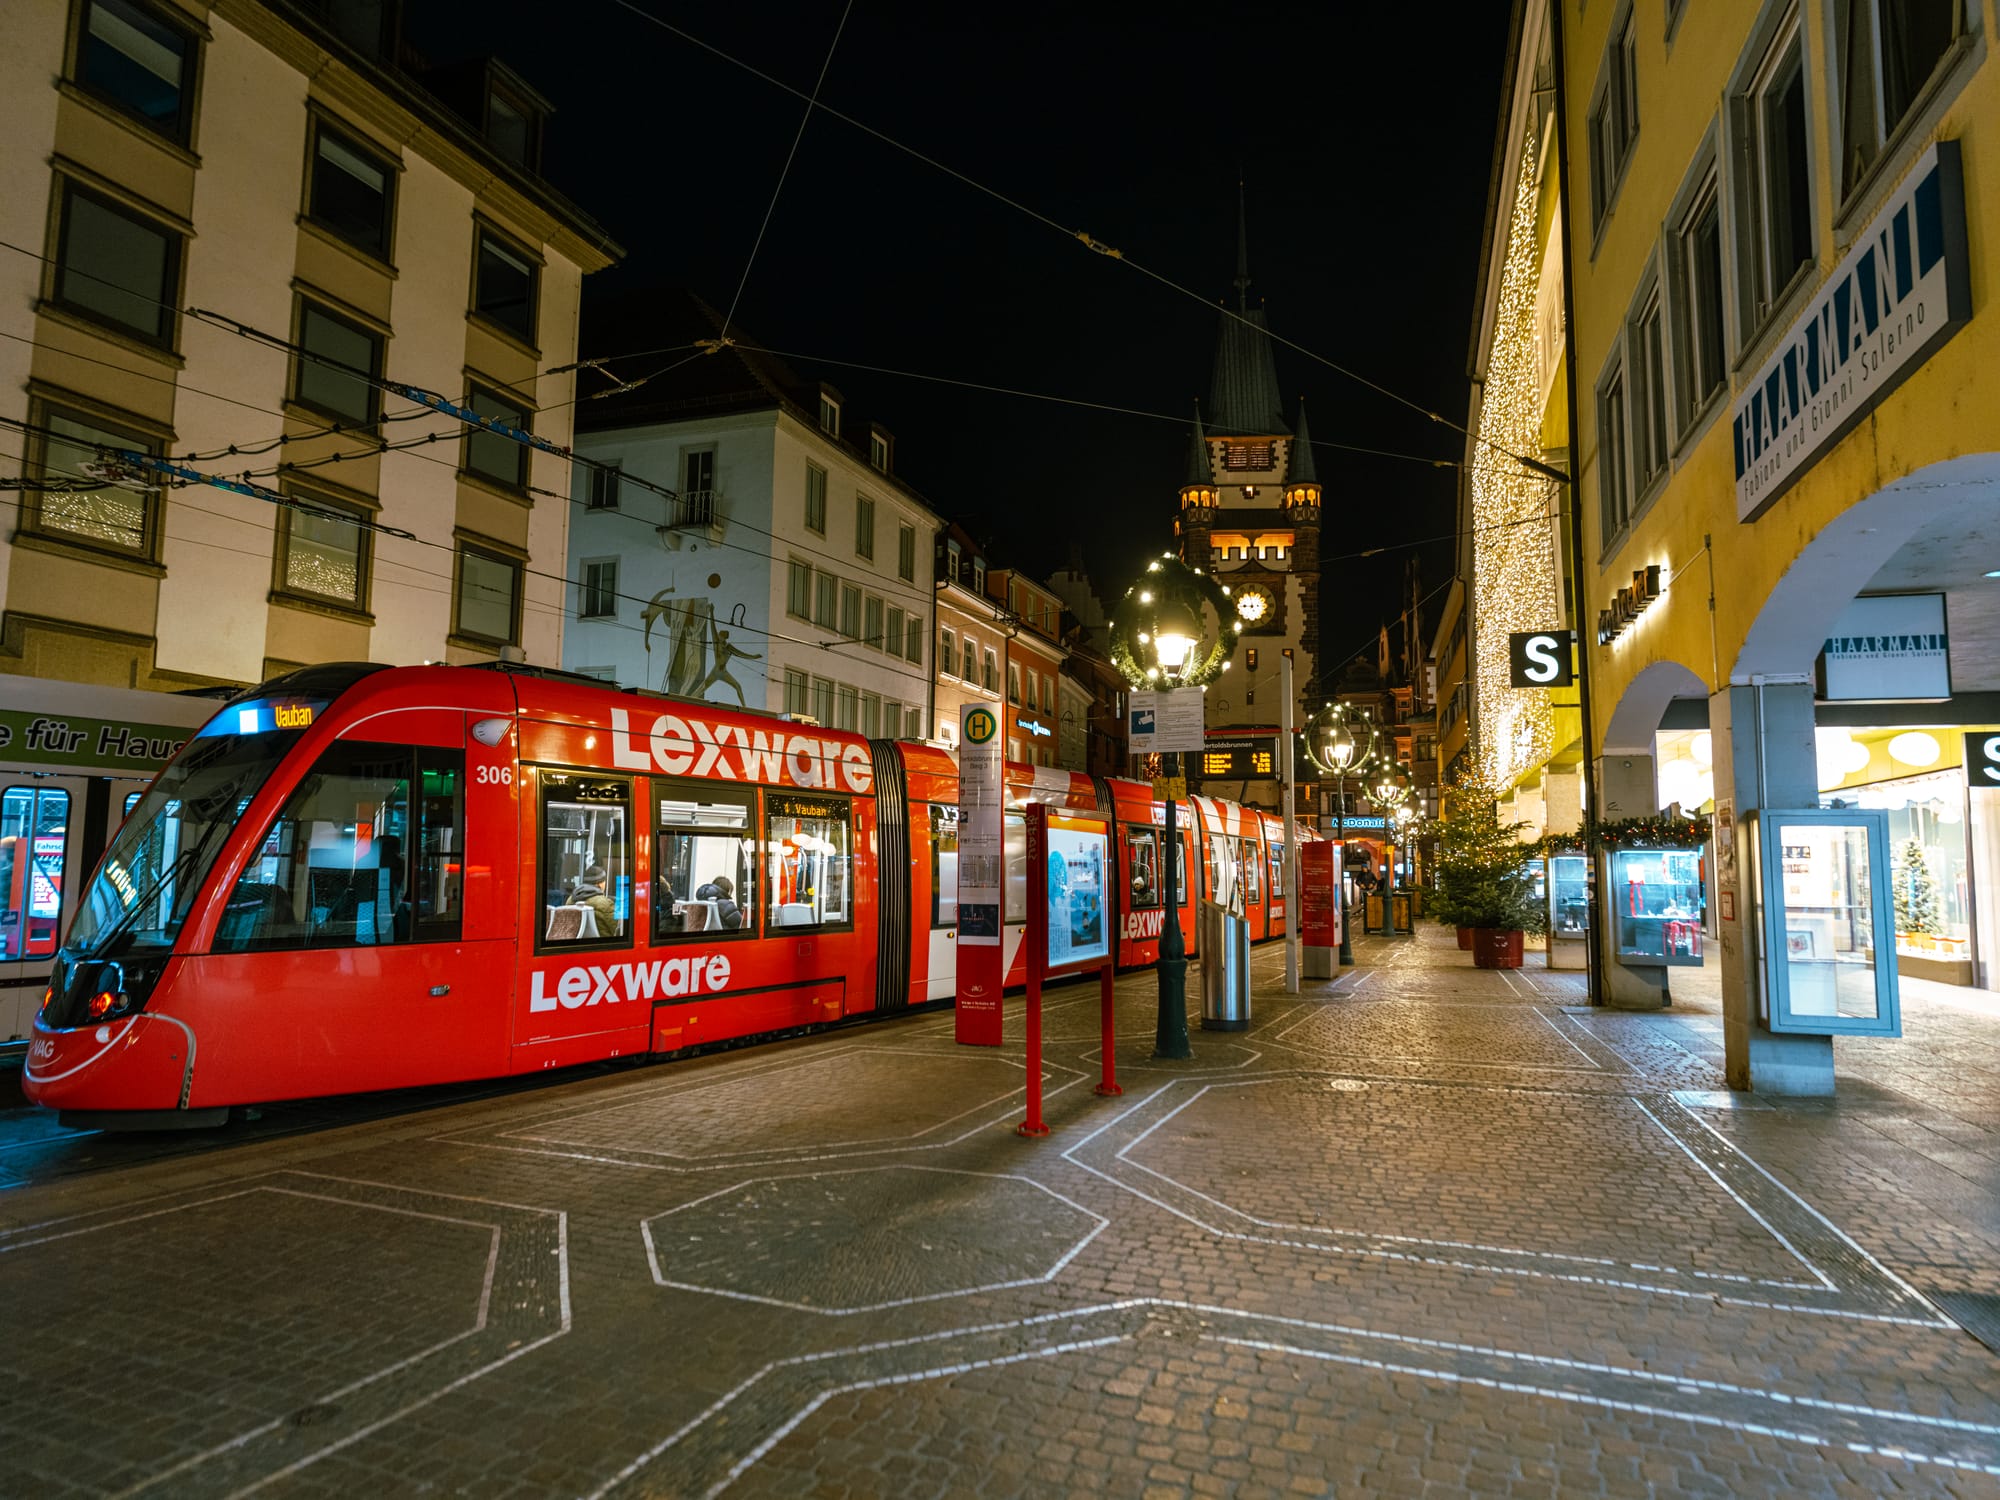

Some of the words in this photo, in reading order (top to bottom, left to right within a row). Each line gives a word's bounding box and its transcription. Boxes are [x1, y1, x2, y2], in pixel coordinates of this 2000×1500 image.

[1786, 417, 1806, 458] und
[1811, 369, 1853, 431] Gianni
[1861, 302, 1926, 381] Salerno
[1524, 635, 1559, 683] S
[275, 705, 313, 728] Vauban
[972, 716, 986, 737] H
[25, 718, 88, 753] für
[610, 707, 873, 793] Lexware
[476, 765, 512, 785] 306
[794, 802, 827, 817] Vauban
[1120, 911, 1180, 940] Lexw
[529, 953, 731, 1013] Lexware
[34, 1040, 55, 1058] VAG
